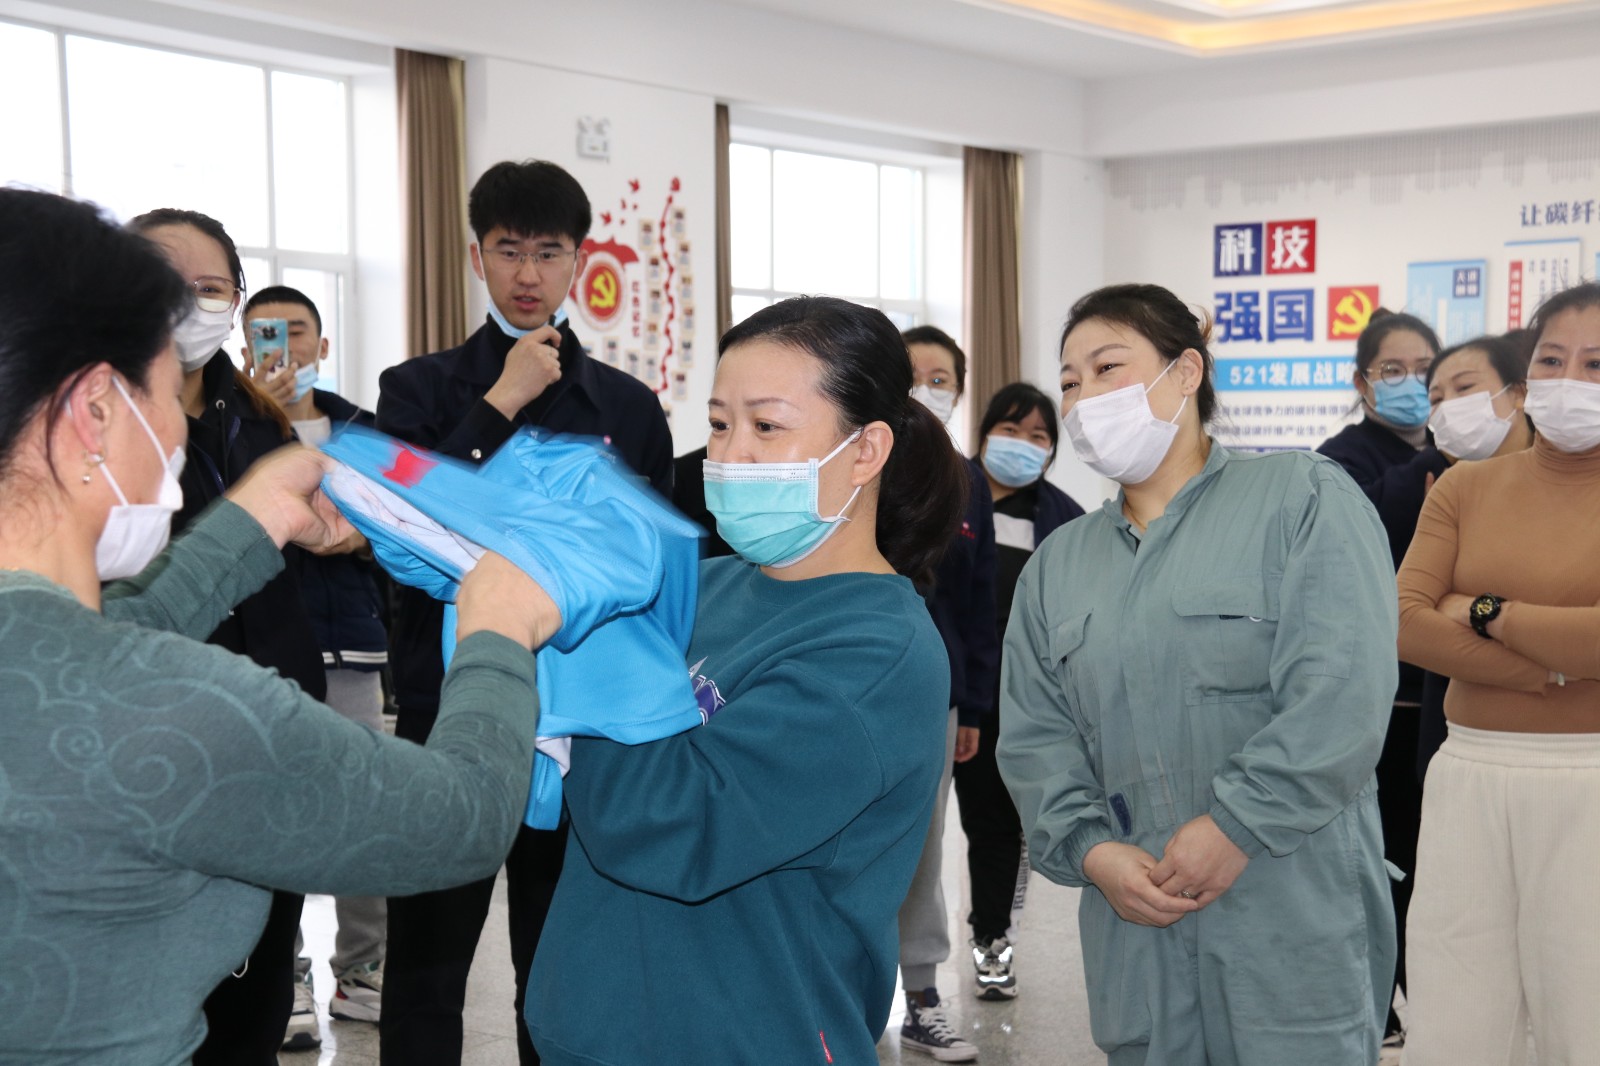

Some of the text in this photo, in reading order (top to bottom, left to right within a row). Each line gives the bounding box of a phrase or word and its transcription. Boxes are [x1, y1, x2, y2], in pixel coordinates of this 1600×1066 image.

[1519, 200, 1600, 228] 让碳纤
[1219, 225, 1309, 272] 科技
[1214, 288, 1314, 343] 强国
